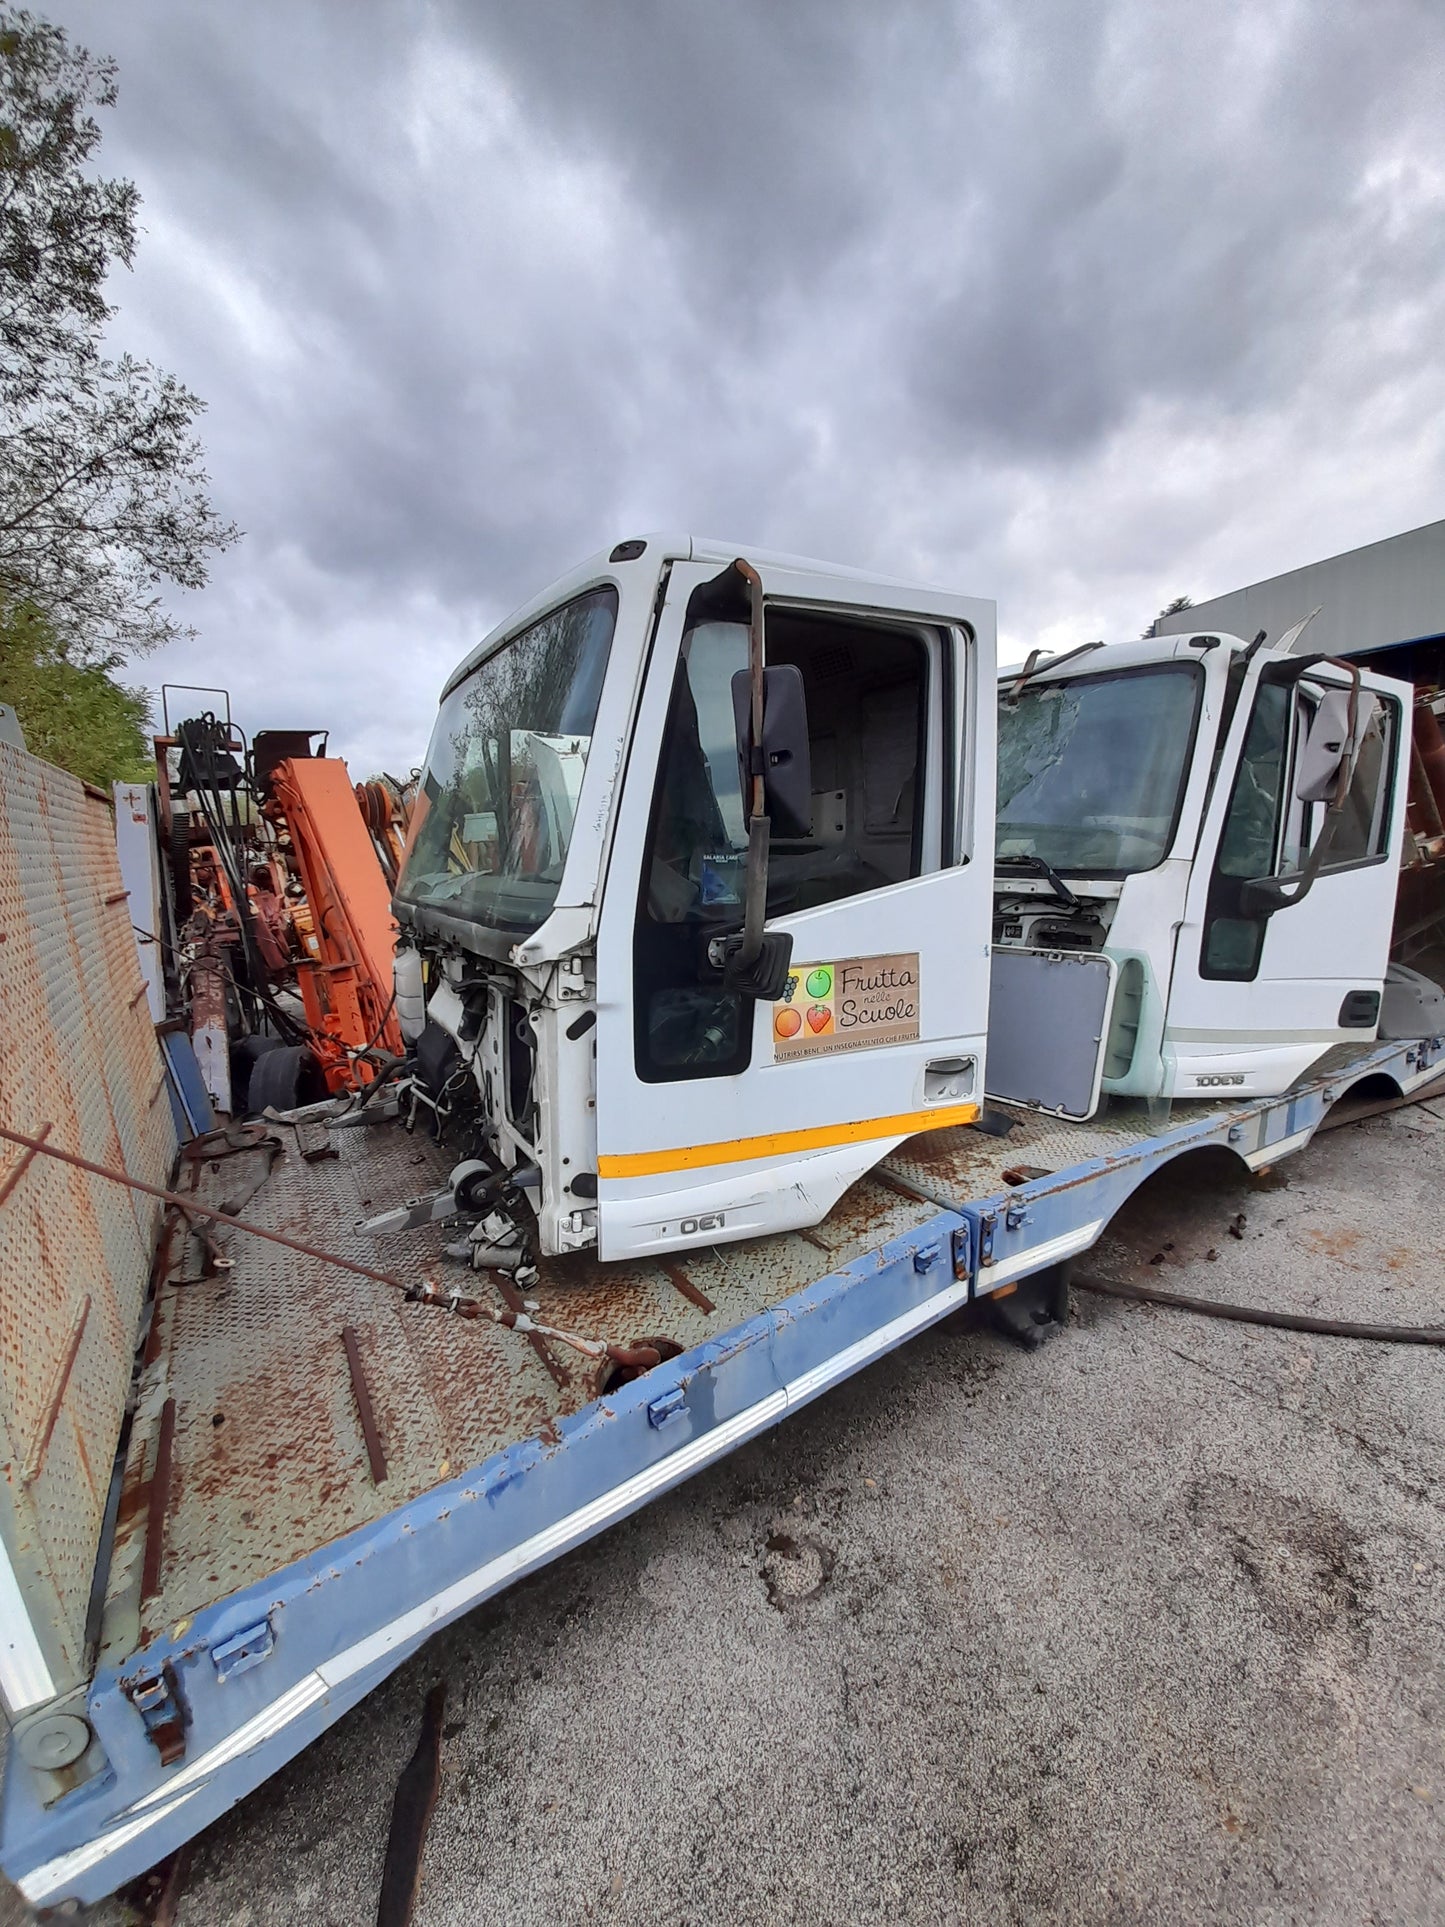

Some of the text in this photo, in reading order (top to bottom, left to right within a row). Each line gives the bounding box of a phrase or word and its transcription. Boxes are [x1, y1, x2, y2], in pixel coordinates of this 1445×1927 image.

[841, 966, 916, 994] Frutta
[863, 991, 892, 1004] nelle
[840, 999, 916, 1027] Scuole
[885, 1035, 897, 1043] CHE
